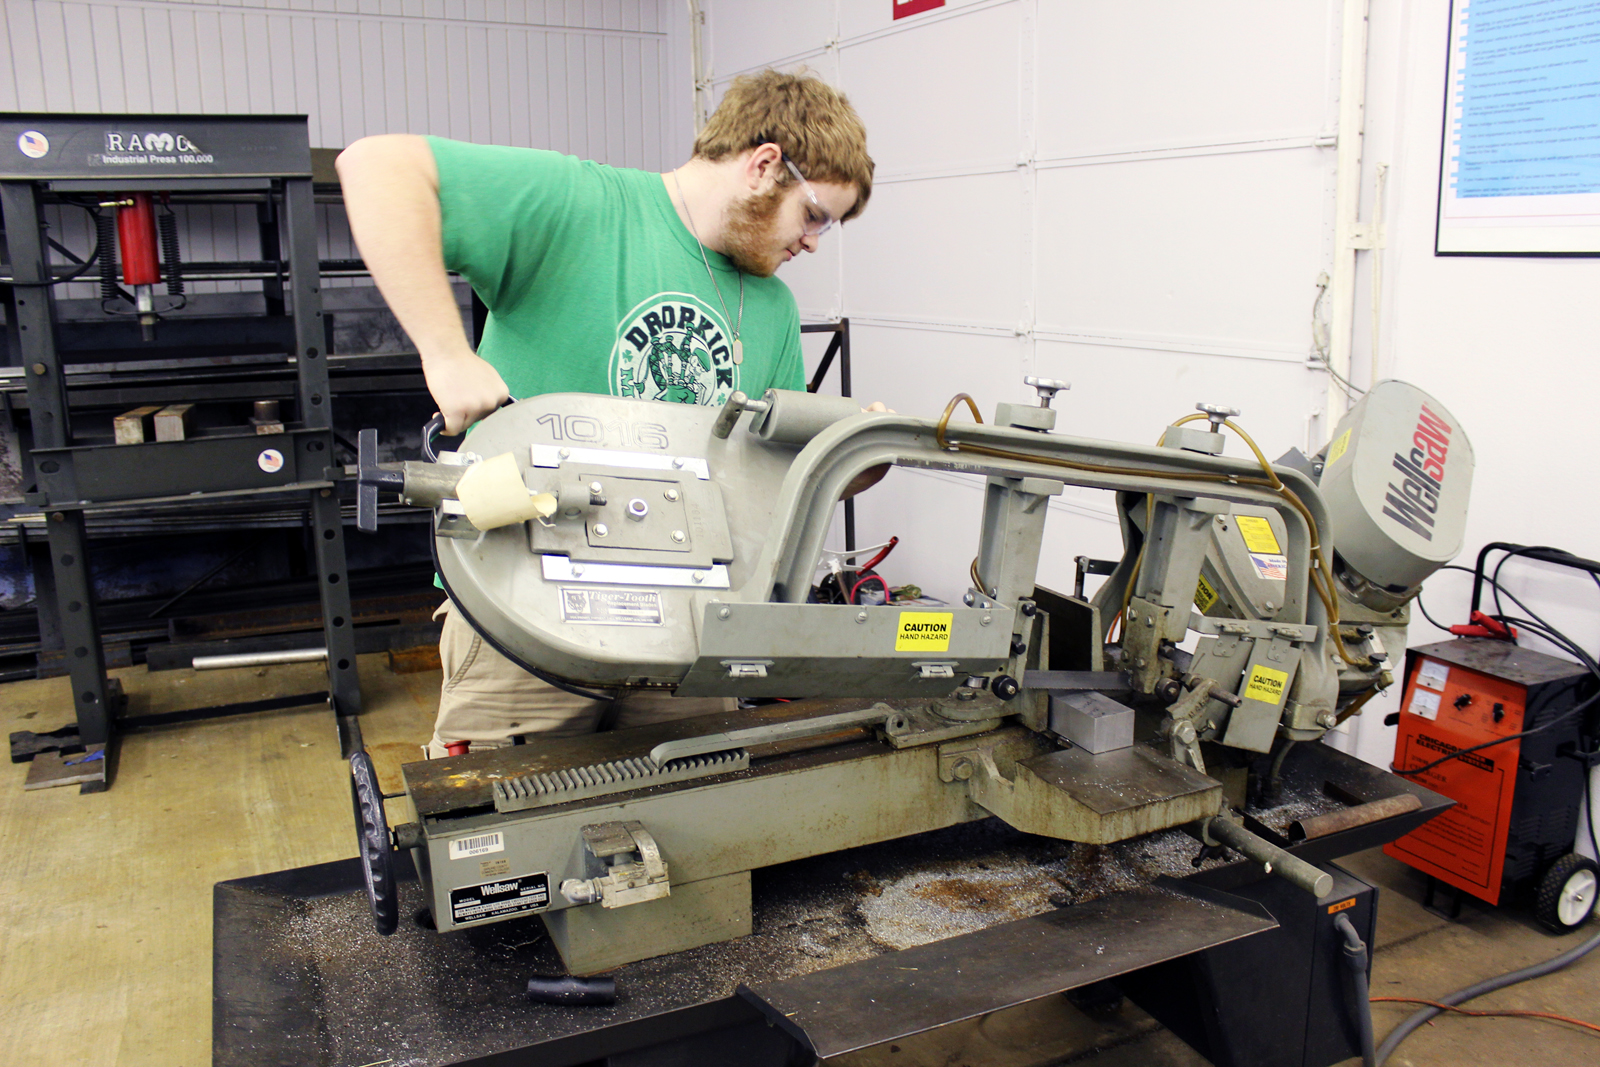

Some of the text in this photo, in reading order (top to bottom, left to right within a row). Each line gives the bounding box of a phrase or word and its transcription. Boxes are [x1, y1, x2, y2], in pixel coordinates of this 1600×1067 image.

[103, 154, 213, 164] Industrial Press 100,000
[625, 305, 733, 389] DROPKICK
[536, 413, 669, 449] 1016
[589, 590, 657, 602] Tiger-Tooth
[1198, 578, 1213, 600] TION
[904, 623, 947, 632] CAUTION
[1253, 675, 1283, 688] CAUTION
[1249, 682, 1282, 696] HAND HAZARD
[1416, 738, 1453, 756] ELECTRI
[1418, 733, 1458, 752] CHICAGO
[480, 882, 518, 896] Wellsaw
